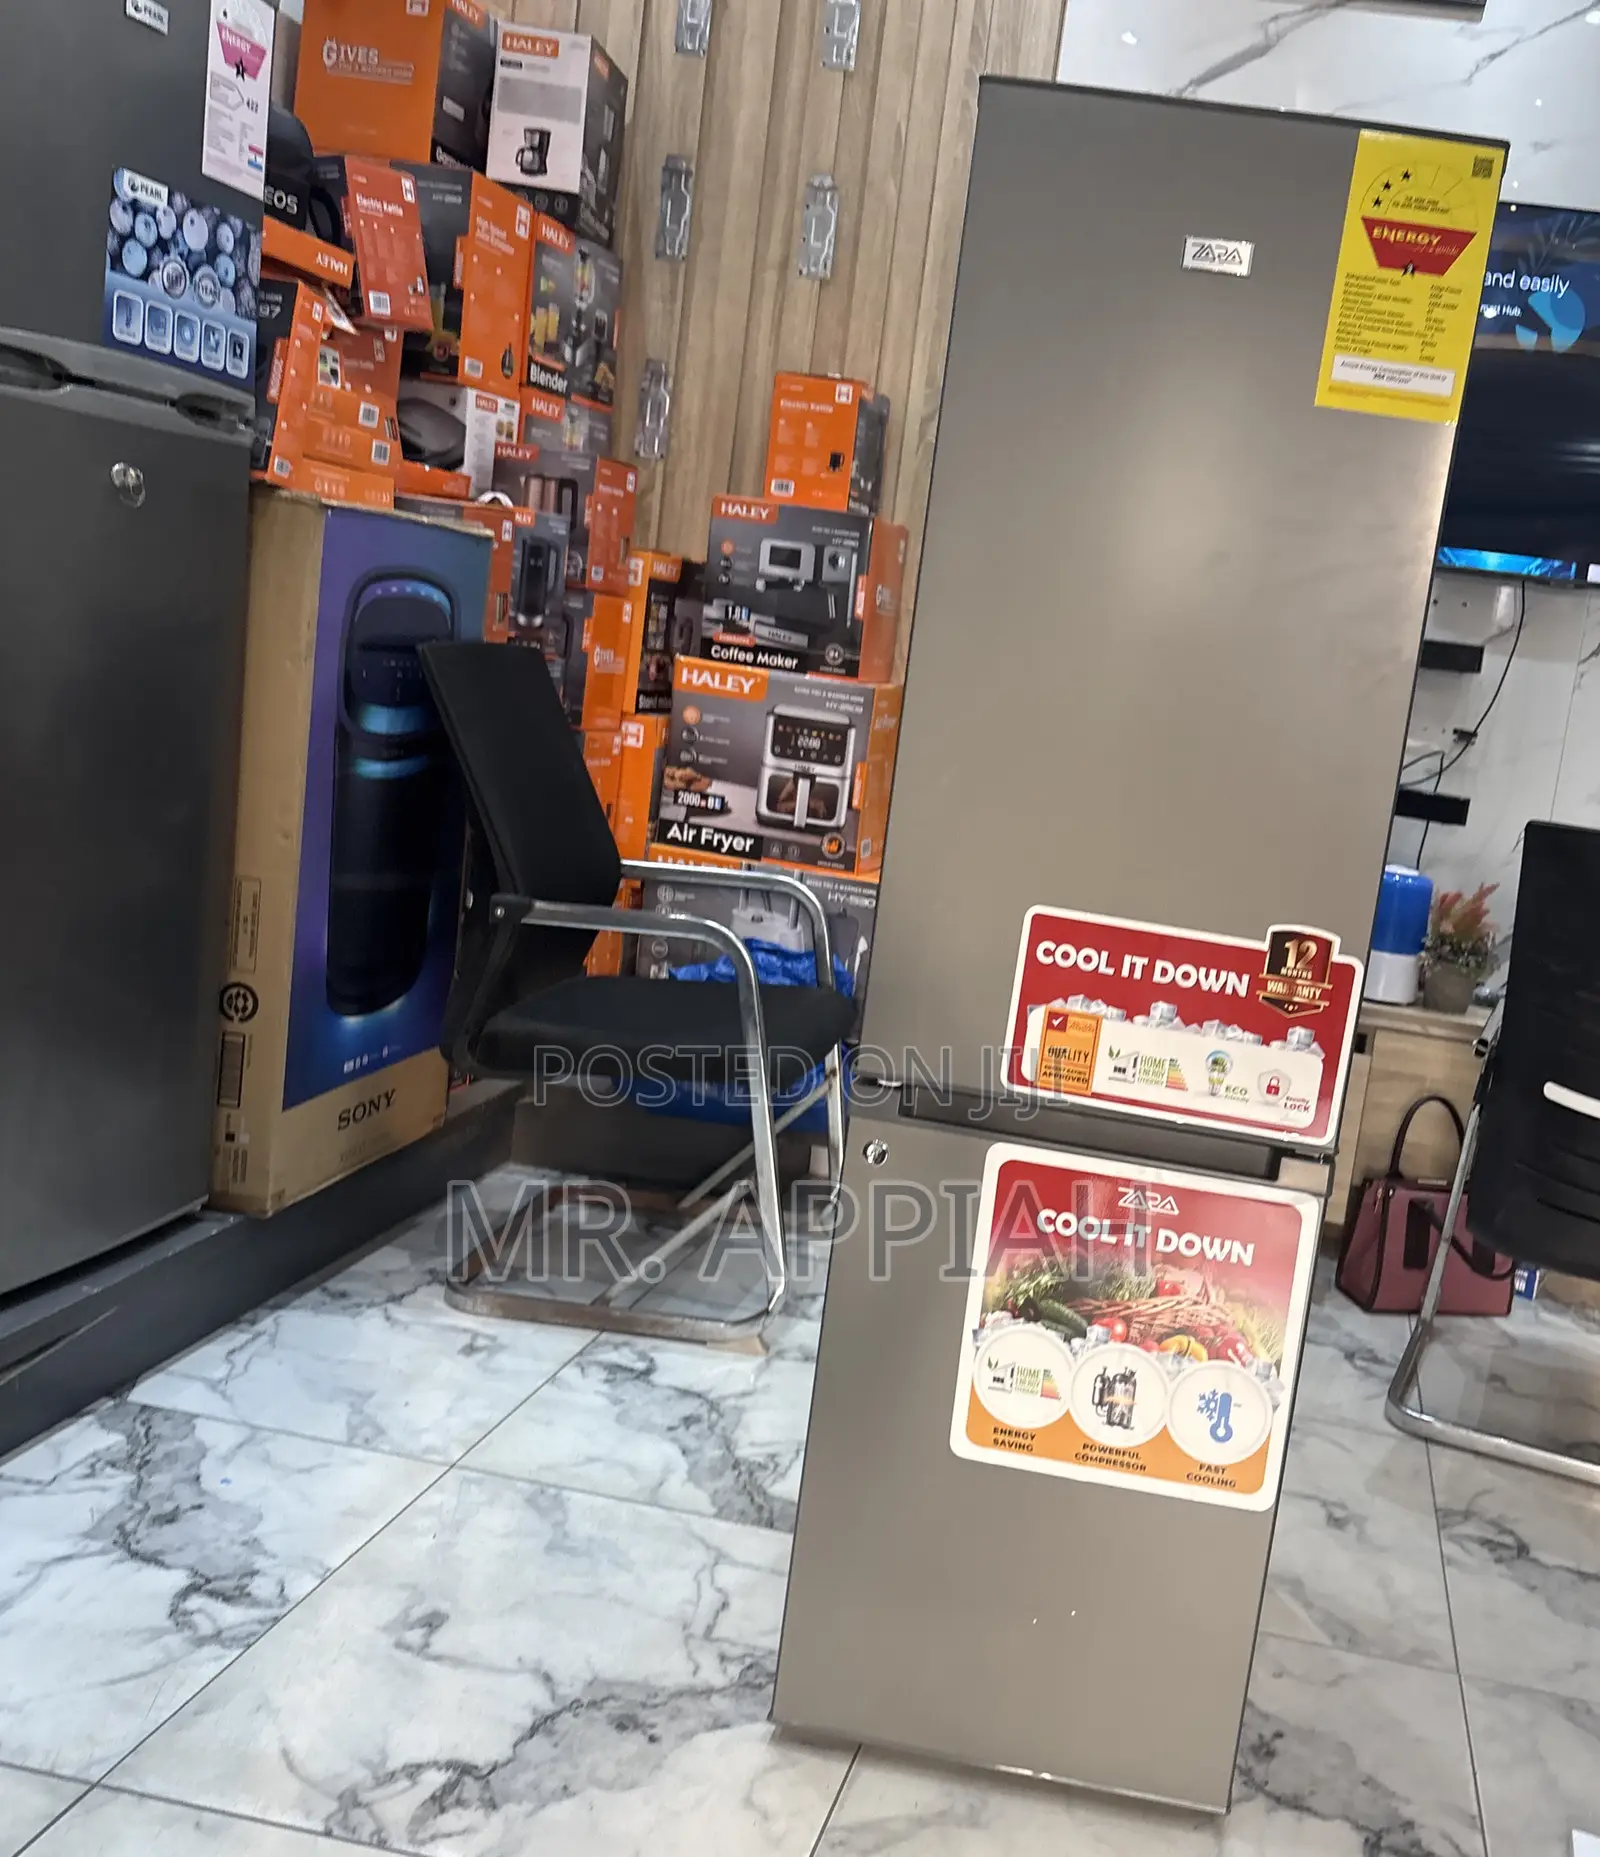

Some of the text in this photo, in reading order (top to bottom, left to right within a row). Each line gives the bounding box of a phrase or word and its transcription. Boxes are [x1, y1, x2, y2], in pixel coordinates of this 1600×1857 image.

[222, 27, 251, 54] ENERGY
[505, 37, 554, 55] HALEY
[139, 179, 163, 200] PEARL
[265, 185, 298, 214] EOS
[542, 222, 570, 250] HALEY
[1372, 225, 1442, 246] ENERGY
[1484, 269, 1570, 299] and easily
[530, 361, 568, 393] Blender
[477, 397, 497, 411] HALEY
[532, 397, 560, 418] HALEY
[497, 446, 532, 460] HALEY
[721, 501, 769, 520] HALEY
[653, 560, 677, 577] HALEY
[711, 644, 799, 670] Coffee Maker
[681, 667, 756, 694] HALEY
[667, 822, 754, 854] Air Fryer
[1284, 939, 1318, 970] 12
[1036, 940, 1251, 998] COOL IT DOWN
[1280, 967, 1313, 980] MONTHS
[1048, 1045, 1090, 1063] QUALITY
[1140, 1055, 1167, 1069] HOME
[1042, 1070, 1089, 1085] APPROVED
[1138, 1066, 1165, 1079] ENERGY
[1225, 1084, 1248, 1097] ECO
[337, 1088, 396, 1131] SONY
[1283, 1103, 1311, 1113] LOCK
[1118, 1186, 1180, 1216] ZARA
[1036, 1208, 1255, 1267] COOL IT DOWN
[1016, 1366, 1041, 1378] HOME
[993, 1426, 1036, 1441] ENERGY
[993, 1437, 1034, 1452] SAVING
[1082, 1442, 1142, 1460] POWERFUL
[1074, 1452, 1147, 1472] COMPRESSOR
[1199, 1463, 1227, 1475] FAST
[1186, 1472, 1237, 1488] COOLING
